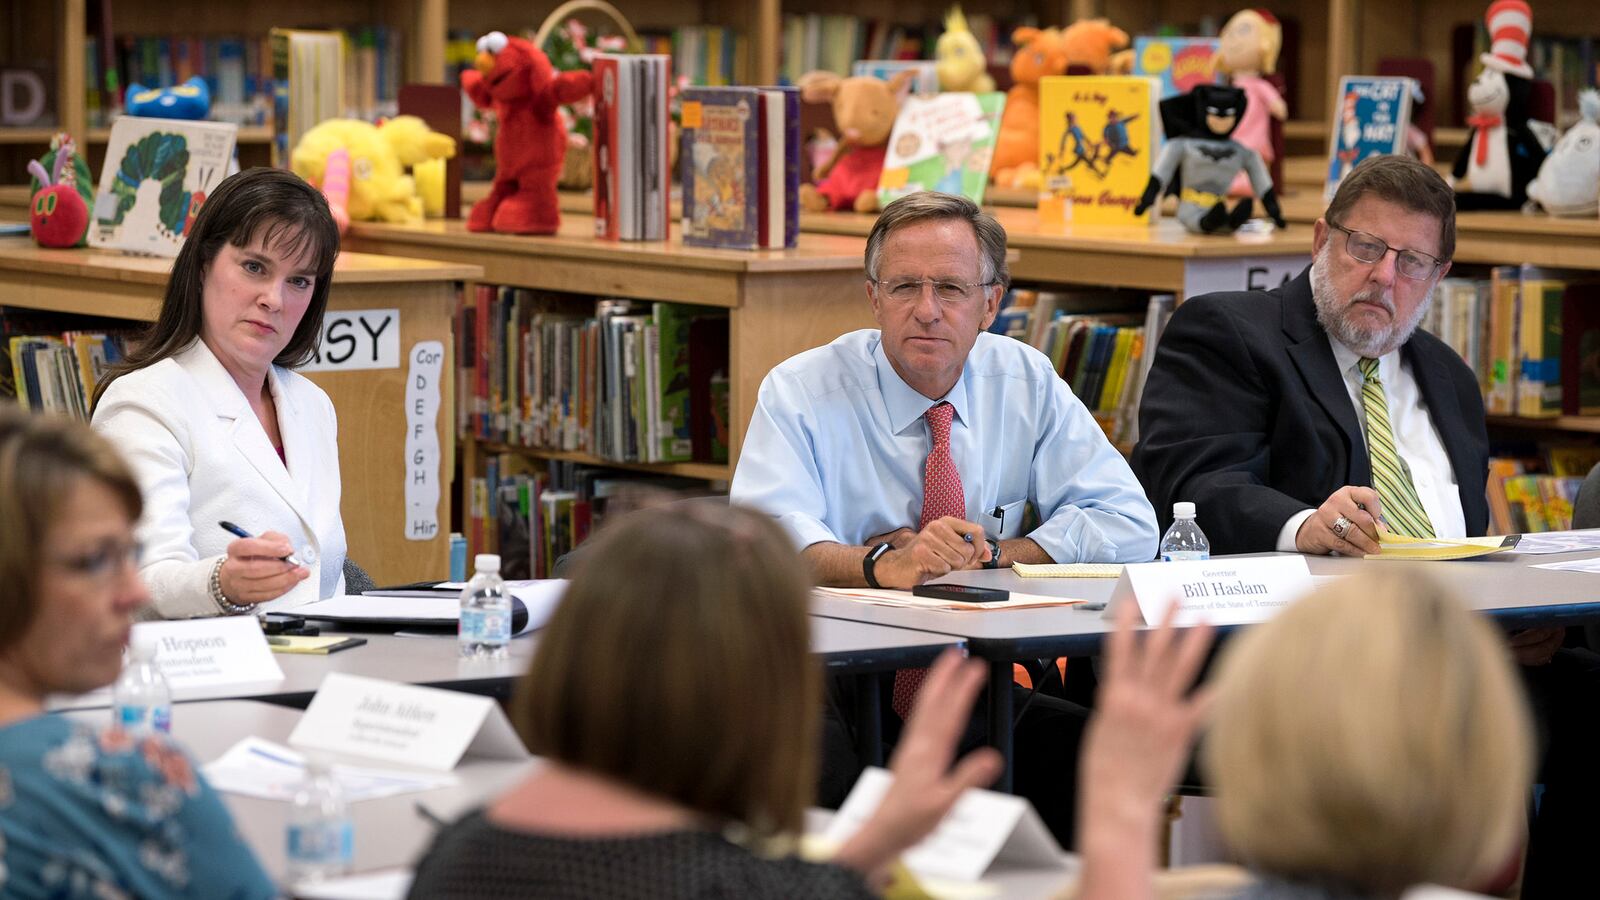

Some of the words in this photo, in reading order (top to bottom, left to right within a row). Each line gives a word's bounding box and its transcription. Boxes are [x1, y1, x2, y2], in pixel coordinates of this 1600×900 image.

[2, 70, 46, 124] D
[314, 315, 392, 364] SY
[416, 349, 441, 364] Cor
[416, 374, 427, 390] D
[414, 399, 425, 415] E
[414, 424, 424, 440] F
[413, 449, 425, 465] G
[414, 470, 426, 485] H
[413, 519, 437, 535] Hir
[1202, 569, 1237, 578] Governor
[1182, 582, 1209, 598] Bill
[1211, 580, 1268, 596] Haslam
[1207, 601, 1215, 609] of
[1216, 600, 1226, 608] the
[1227, 599, 1244, 608] State
[1246, 599, 1253, 608] of
[162, 636, 227, 654] Hopson
